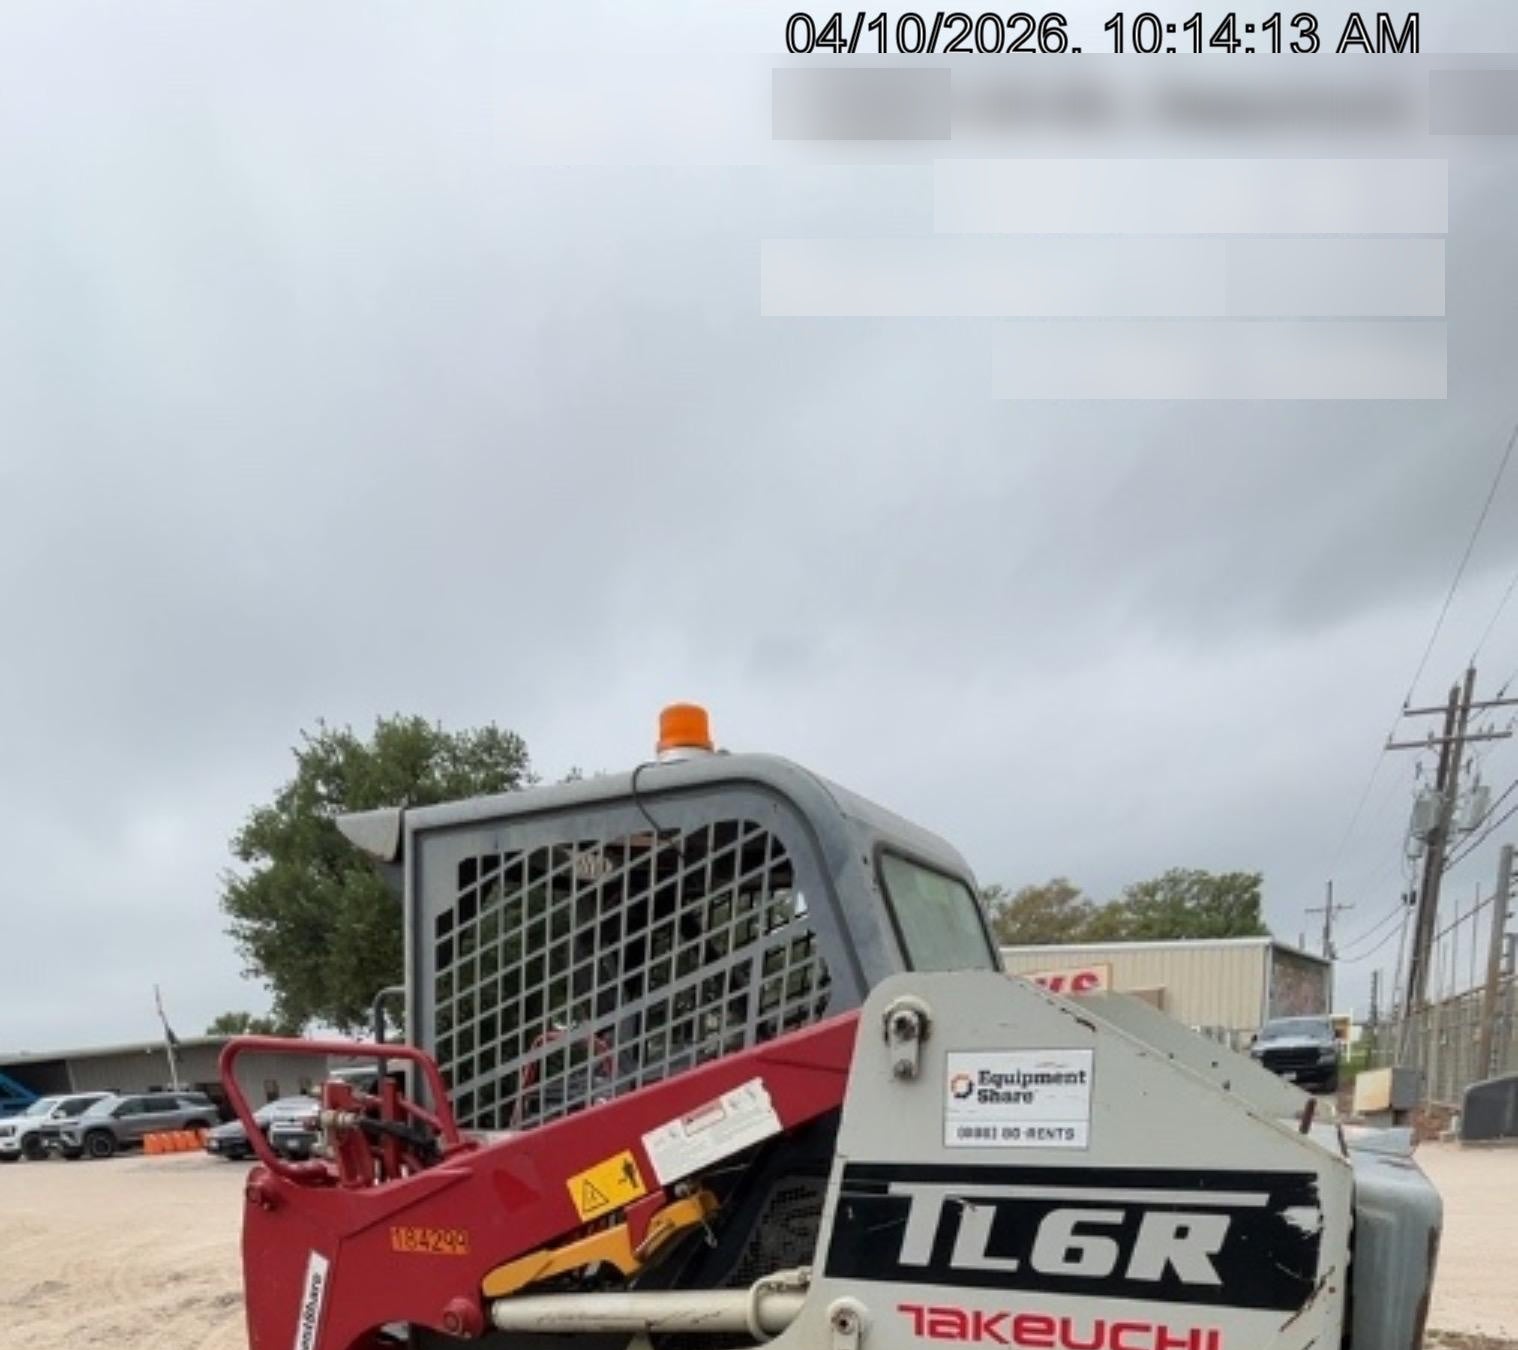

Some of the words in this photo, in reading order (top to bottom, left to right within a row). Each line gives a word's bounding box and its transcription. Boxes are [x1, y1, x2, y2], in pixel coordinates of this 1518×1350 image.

[978, 1069, 1087, 1088] Equipment
[977, 1088, 1033, 1104] Share
[888, 1182, 1269, 1285] TL6R
